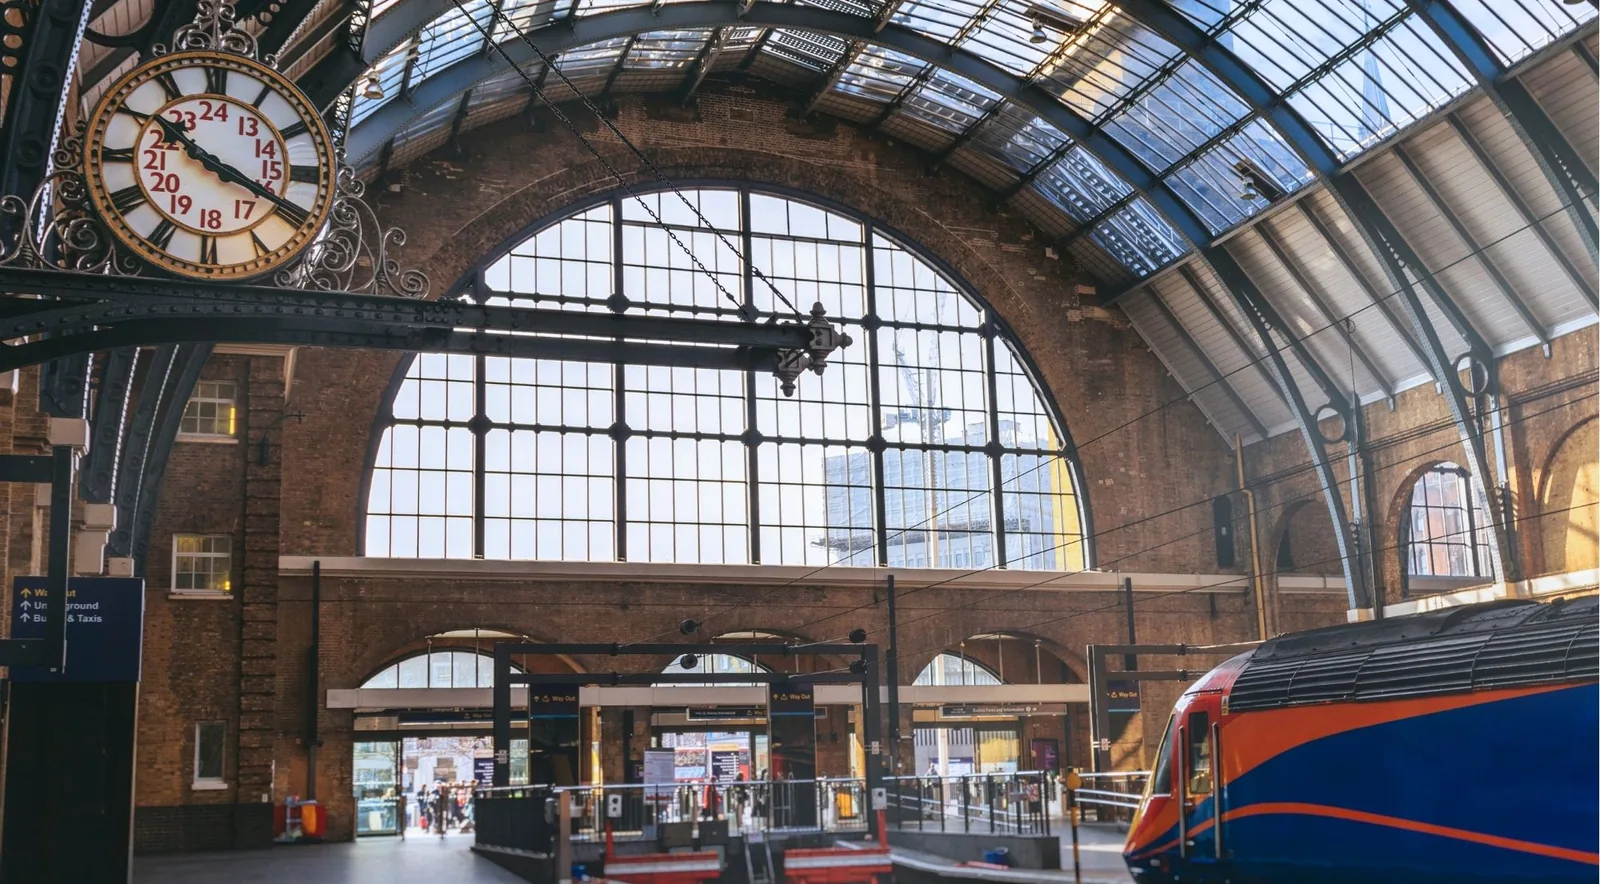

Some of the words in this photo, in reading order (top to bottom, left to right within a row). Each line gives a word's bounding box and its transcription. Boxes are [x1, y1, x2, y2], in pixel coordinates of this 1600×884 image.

[199, 101, 228, 122] 24
[239, 116, 259, 136] 13
[255, 139, 275, 159] 14
[144, 150, 165, 170] 21
[262, 160, 282, 180] 15
[150, 172, 180, 193] 20
[171, 195, 192, 215] 19
[234, 200, 256, 220] 17
[200, 209, 222, 229] 18
[34, 601, 99, 611] Unground
[77, 614, 103, 622] Taxis
